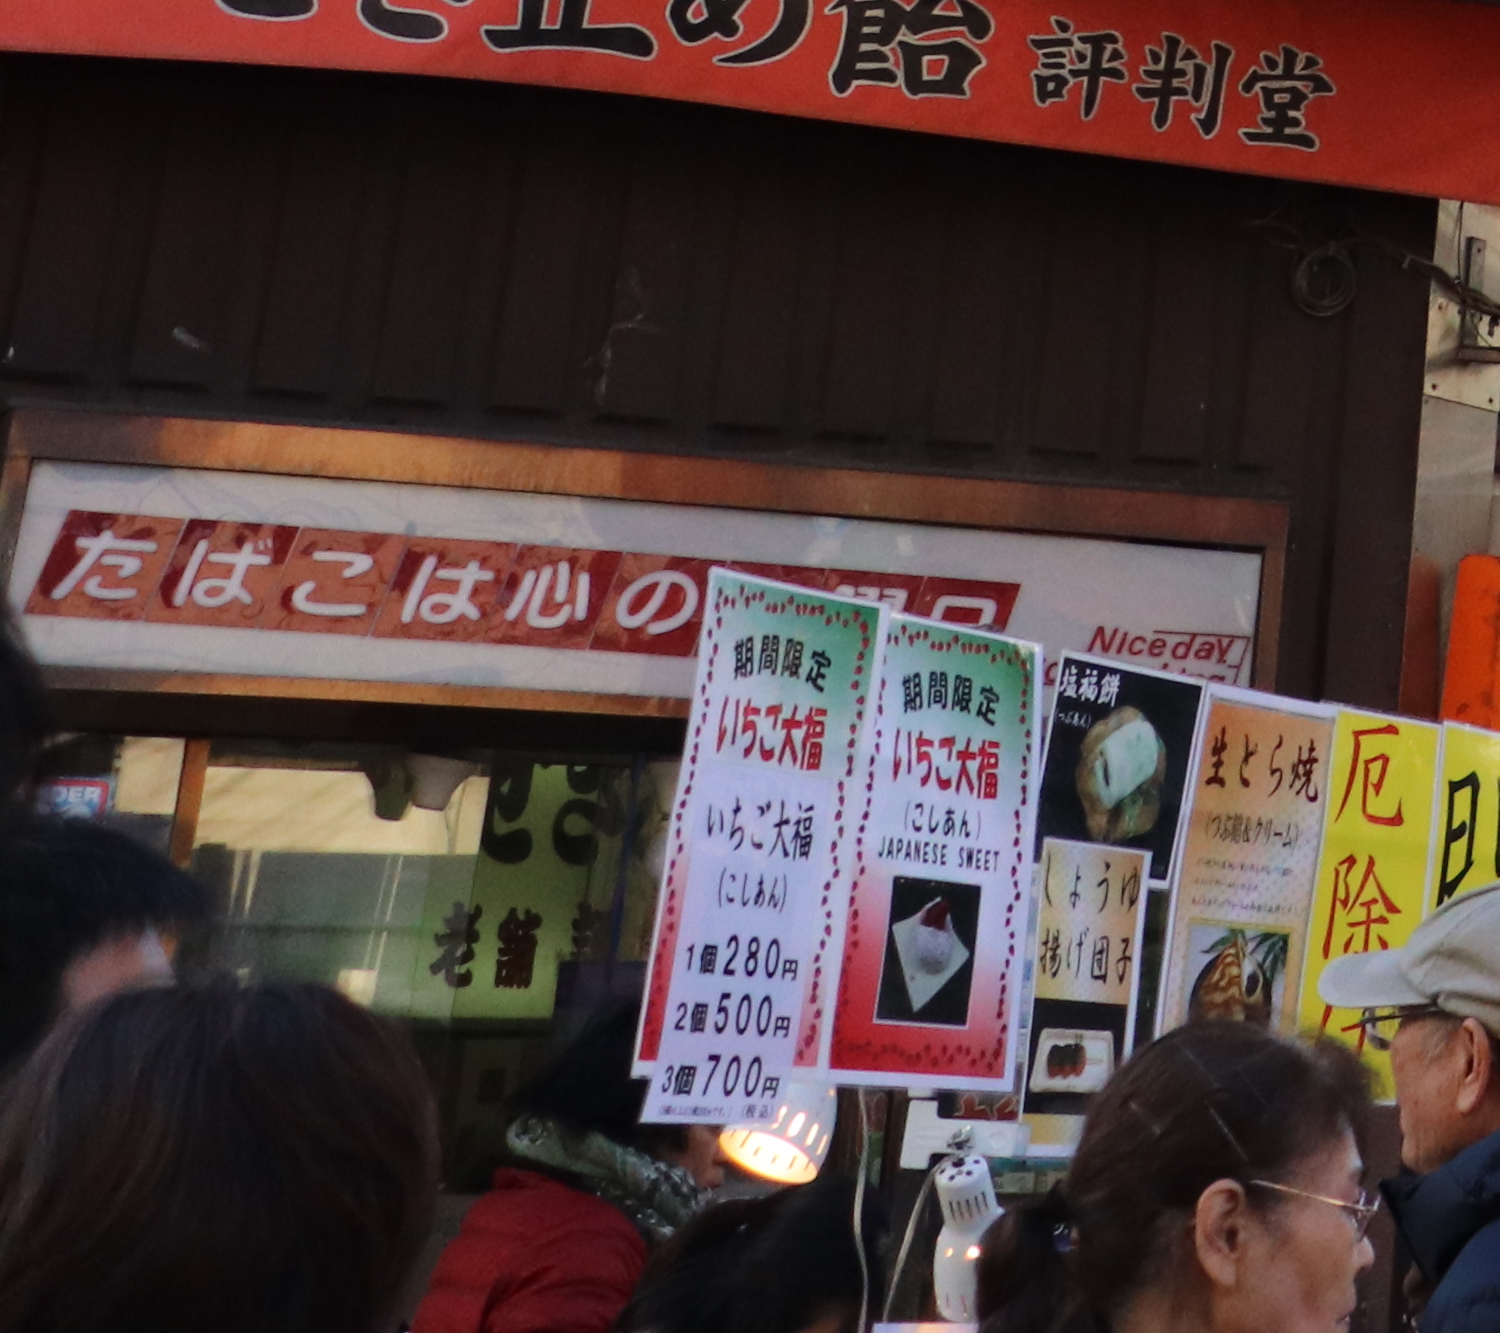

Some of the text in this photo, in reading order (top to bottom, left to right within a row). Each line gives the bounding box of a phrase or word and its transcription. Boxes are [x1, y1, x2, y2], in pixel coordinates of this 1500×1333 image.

[1027, 15, 1338, 153] 評判堂
[53, 529, 997, 635] たばこは心の
[733, 634, 833, 694] 期間限定
[1087, 626, 1236, 664] Nice day
[901, 671, 1001, 727] 期間限定
[1059, 664, 1121, 708] 塩福餅
[715, 695, 829, 772] いちご大福
[891, 726, 1002, 801] いちご大福
[705, 795, 816, 862] いちご大福
[878, 835, 1001, 871] JAPANESE SWEET
[1045, 854, 1141, 914] しょうゆ
[1322, 723, 1404, 1053] 厄除
[1039, 926, 1132, 985] 揚げ団子
